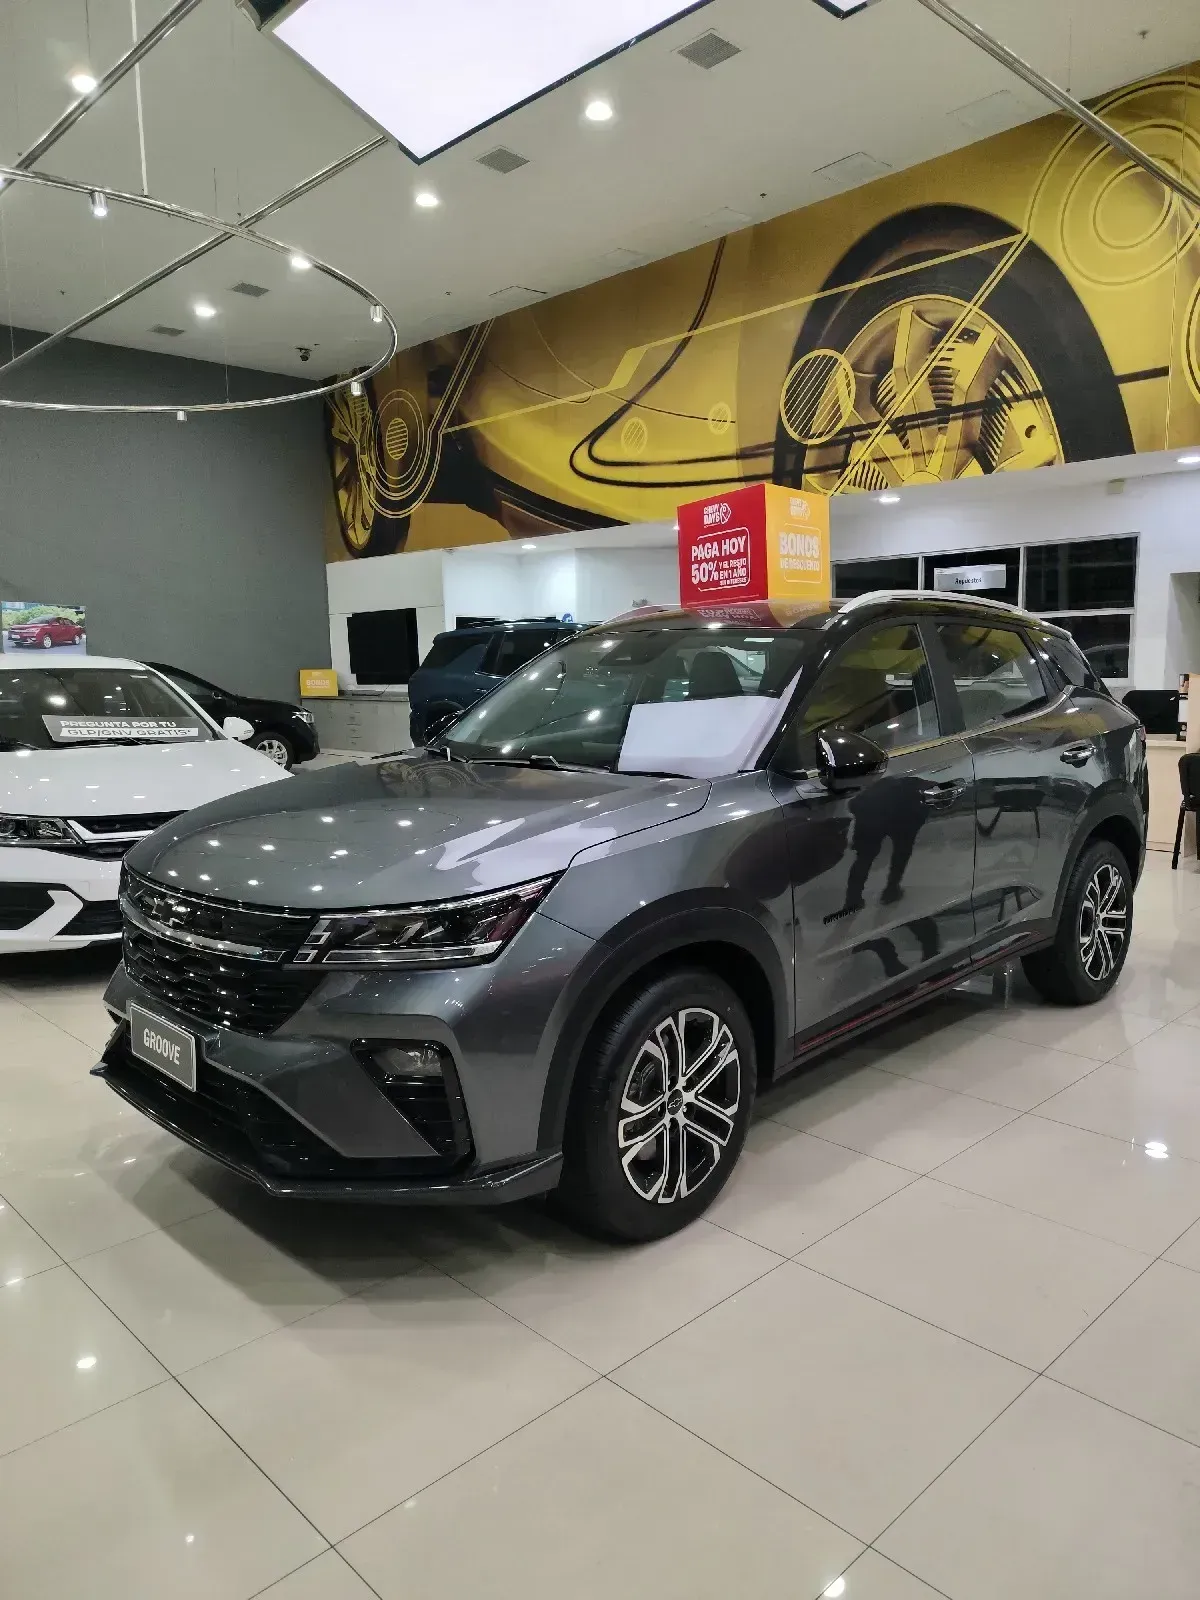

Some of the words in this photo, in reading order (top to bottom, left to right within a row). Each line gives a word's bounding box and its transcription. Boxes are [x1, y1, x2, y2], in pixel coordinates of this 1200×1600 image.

[704, 512, 720, 525] DAYS
[691, 541, 720, 561] PAGA
[721, 536, 746, 556] HOY
[779, 531, 820, 558] BONOS
[691, 560, 719, 584] 50%
[730, 557, 747, 568] RESTO
[720, 570, 729, 580] EN
[732, 566, 747, 578] AÑO
[60, 720, 130, 728] PREGUNTA
[143, 1028, 181, 1066] GROOVE
